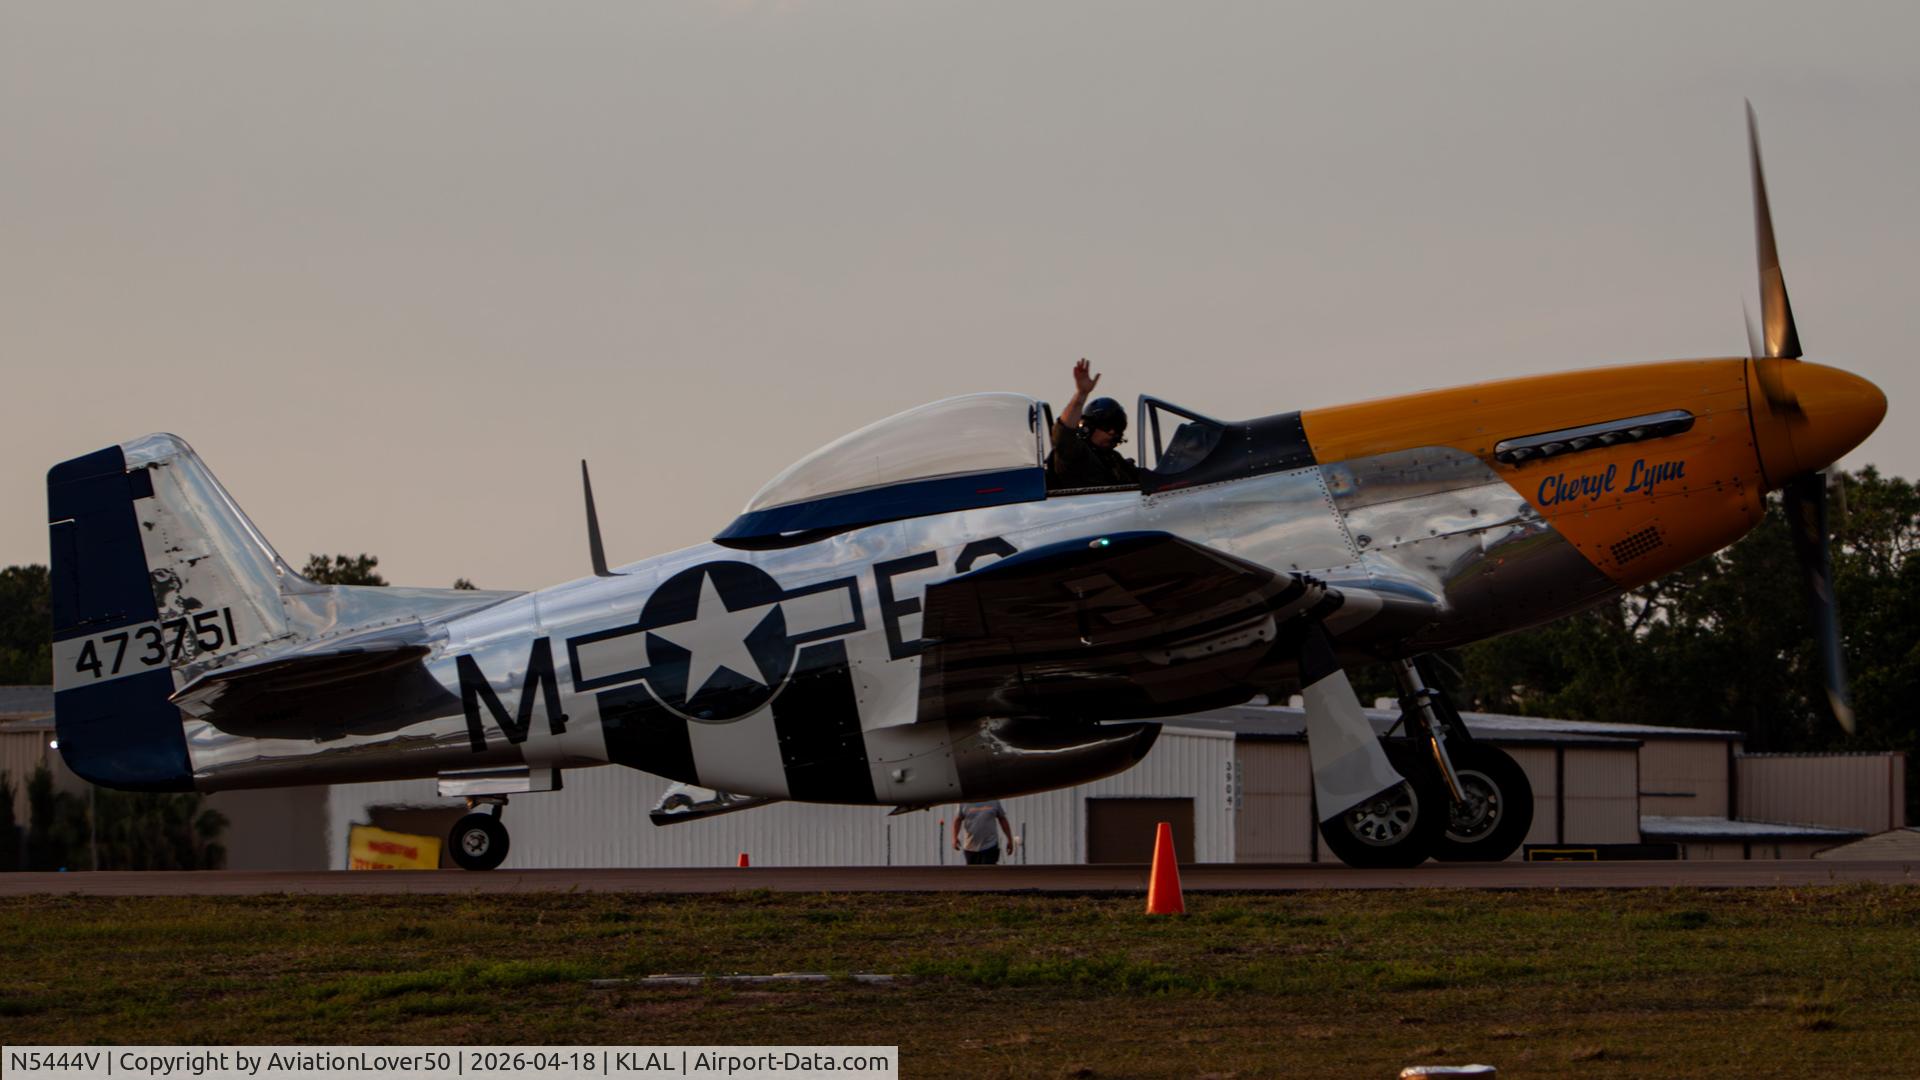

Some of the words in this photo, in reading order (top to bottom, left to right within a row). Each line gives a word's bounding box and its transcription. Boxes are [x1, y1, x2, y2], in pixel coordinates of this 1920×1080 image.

[1537, 463, 1617, 506] Cheryl
[1624, 458, 1686, 497] Lynn
[76, 607, 238, 678] 473751
[455, 636, 567, 754] M
